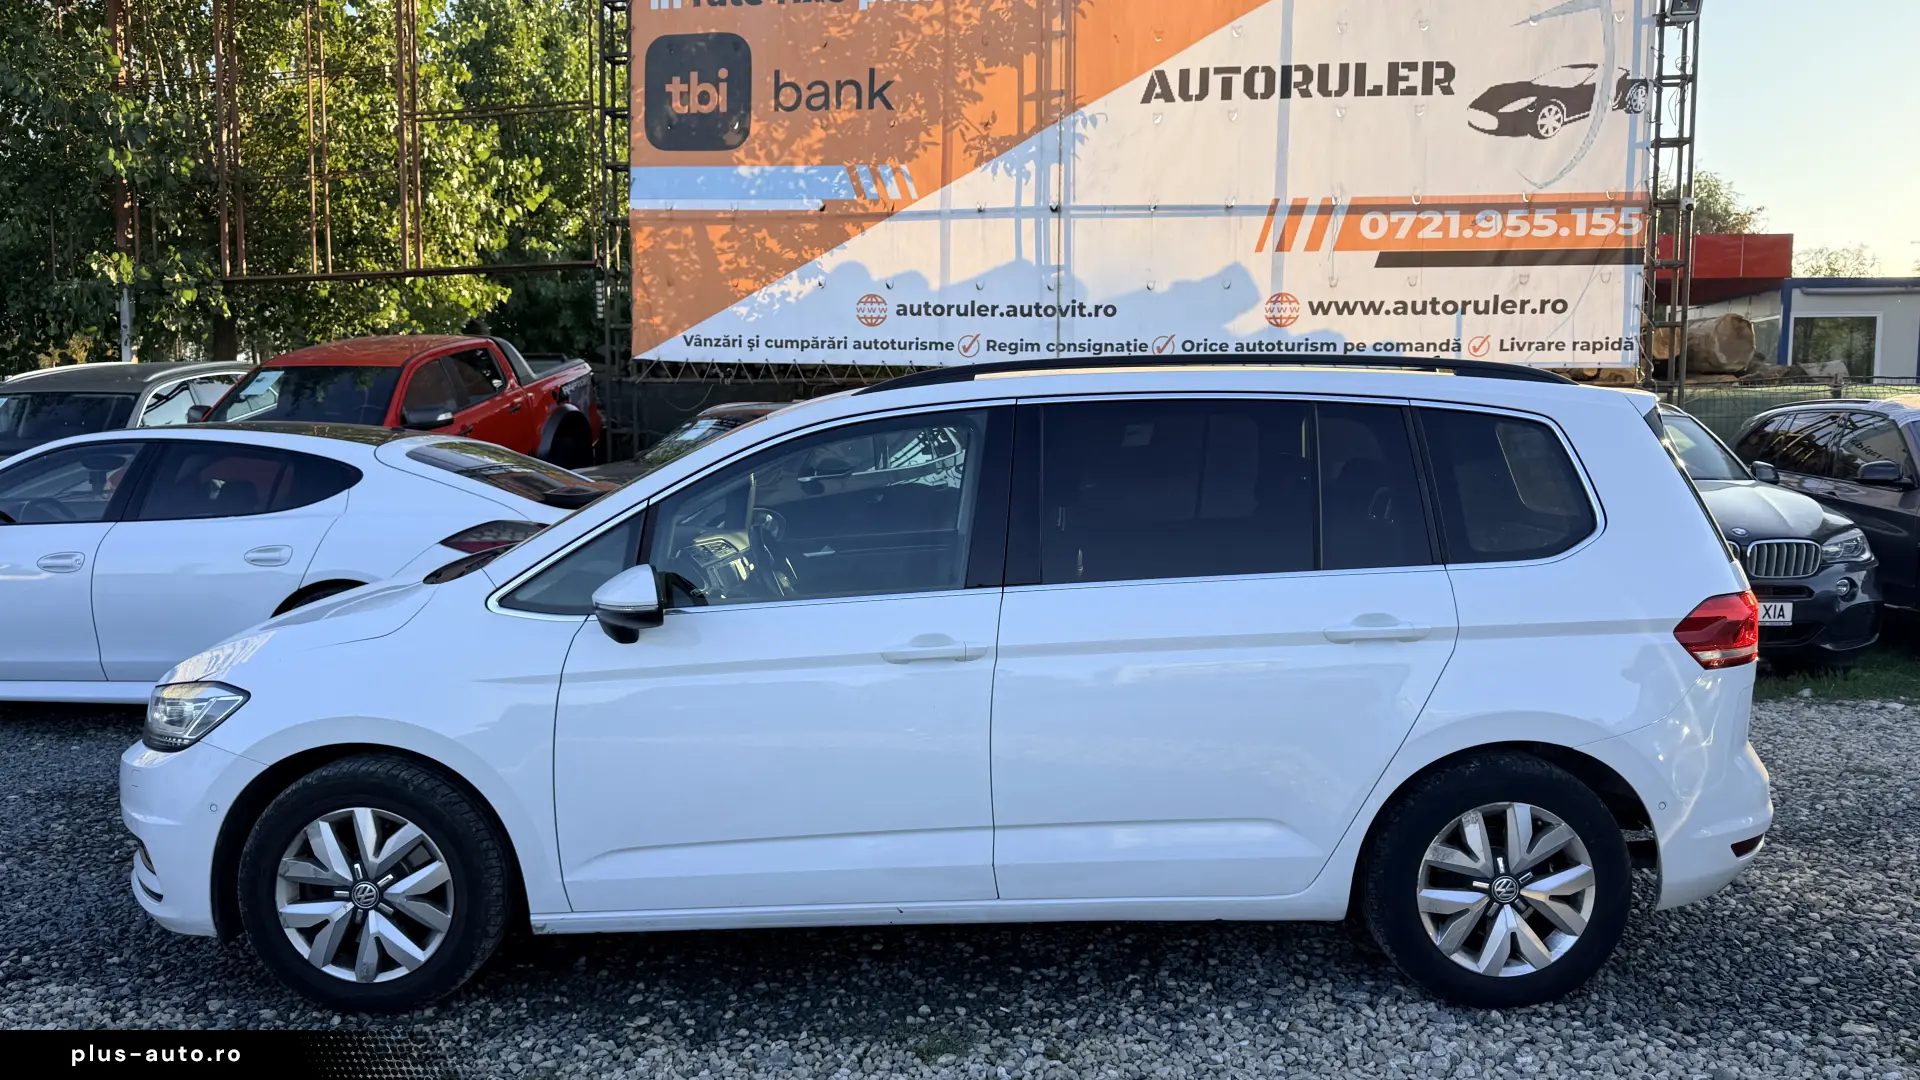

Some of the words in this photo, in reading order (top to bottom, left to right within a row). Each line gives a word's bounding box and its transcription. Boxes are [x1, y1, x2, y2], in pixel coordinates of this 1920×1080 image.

[665, 68, 728, 114] tbi
[773, 68, 895, 112] bank
[1140, 61, 1456, 104] AUTORULER
[1359, 207, 1643, 240] 0721.955.155
[895, 300, 1117, 319] autoruler.autovit.ro
[1308, 294, 1569, 316] www.autoruler.ro
[683, 335, 742, 348] Vânzări
[764, 336, 848, 351] cumpărări
[853, 338, 955, 351] autoturisme
[986, 338, 1041, 354] Regim
[1181, 338, 1229, 353] Orice
[1234, 338, 1337, 353] autoturism
[1343, 341, 1366, 355] pe
[1372, 338, 1462, 353] comandă
[1499, 337, 1566, 352] Livrare
[1572, 336, 1635, 354] rapidă
[1762, 604, 1785, 620] XIA
